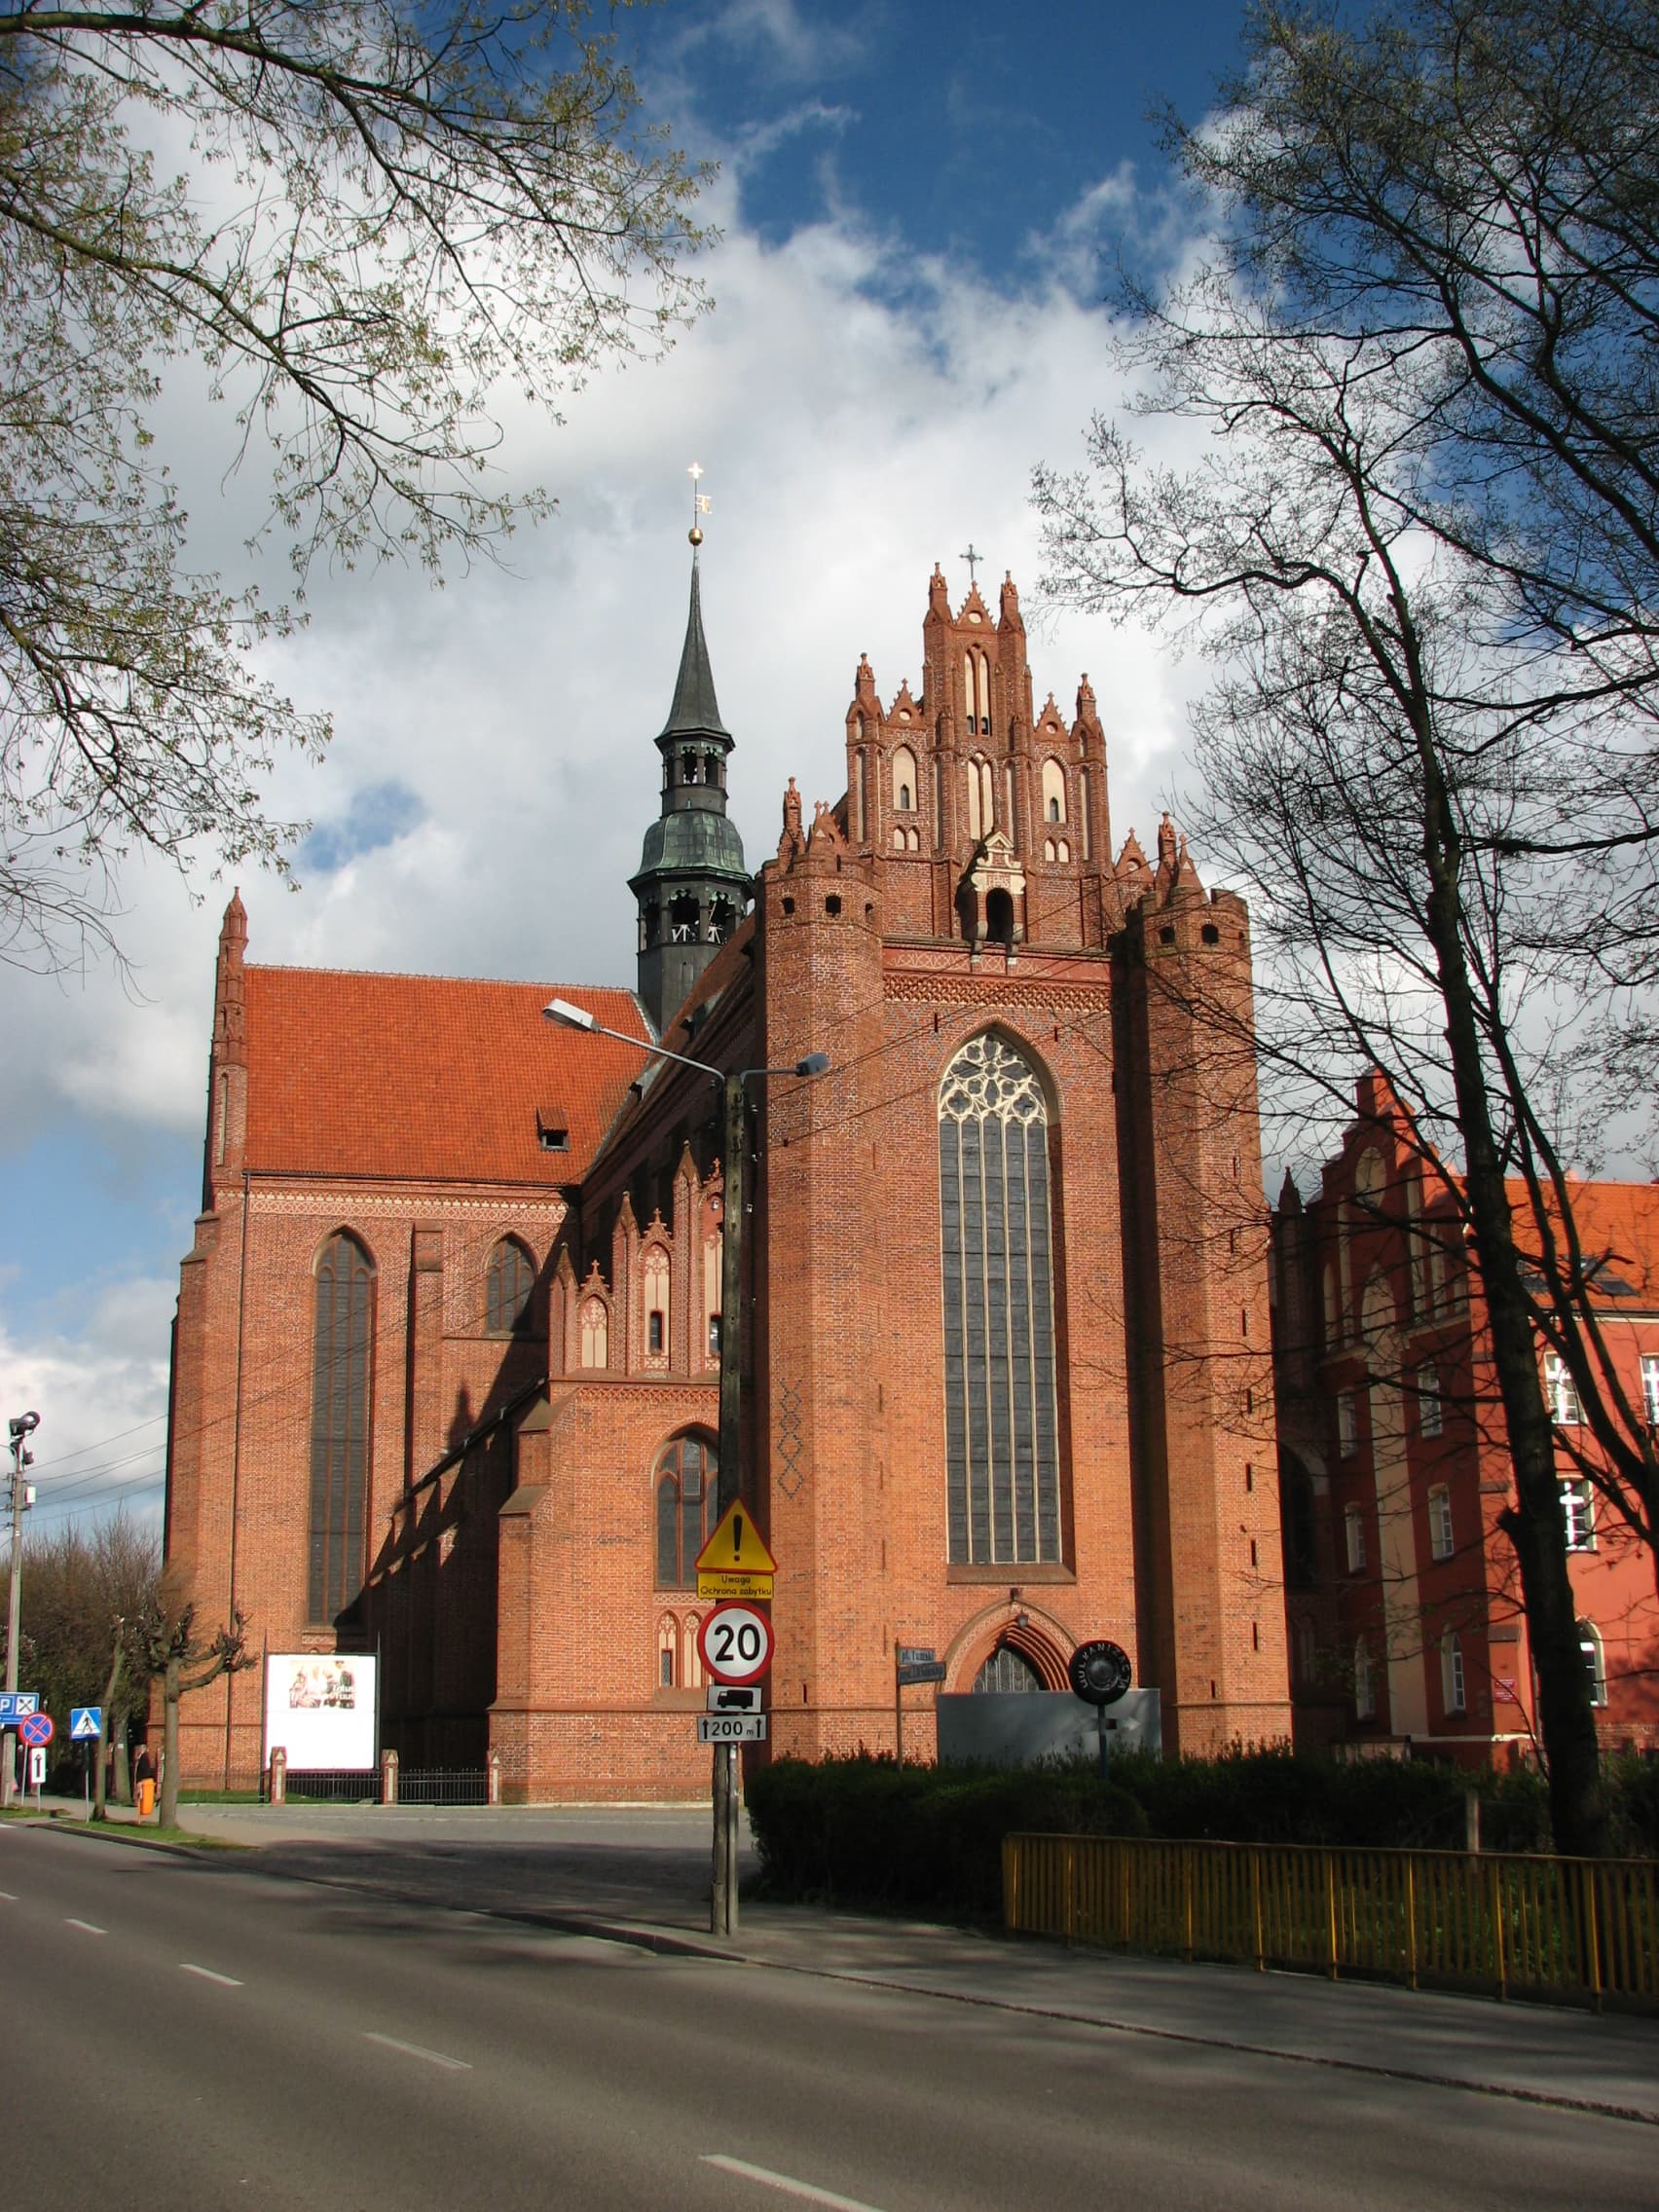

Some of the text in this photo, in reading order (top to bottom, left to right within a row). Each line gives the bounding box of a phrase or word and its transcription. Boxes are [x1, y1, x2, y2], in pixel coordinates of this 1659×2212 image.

[721, 1575, 751, 1586] Uwaga
[701, 1586, 772, 1597] Ochrona zabytku
[714, 1623, 760, 1662] 20
[1078, 1642, 1129, 1689] WULKANIZACJA
[712, 1721, 743, 1736] 200
